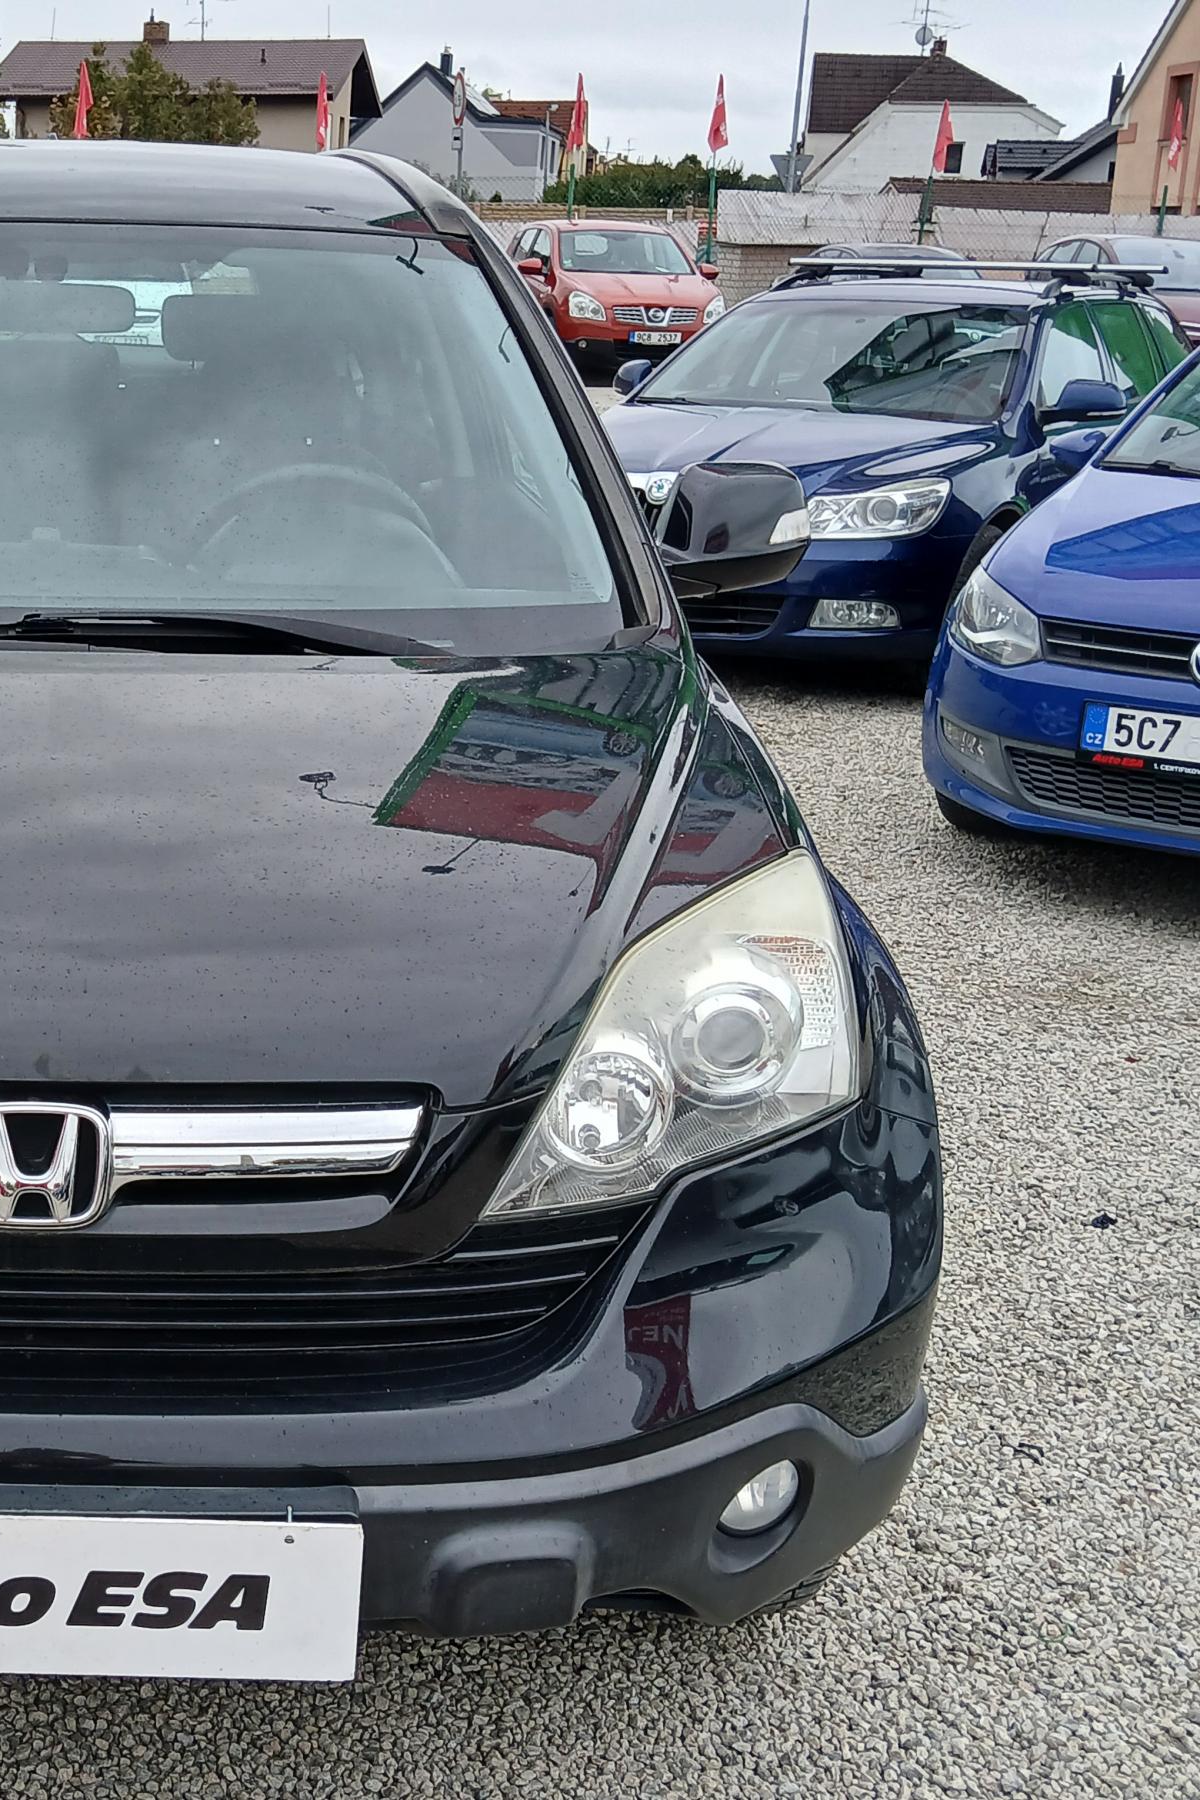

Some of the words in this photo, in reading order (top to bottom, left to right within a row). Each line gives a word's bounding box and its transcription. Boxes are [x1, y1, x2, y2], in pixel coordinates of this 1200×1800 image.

[636, 333, 652, 342] 9C8
[1086, 732, 1103, 745] CZ
[1114, 712, 1182, 754] 5C7
[1093, 753, 1121, 765] Auto
[65, 1569, 271, 1631] ESA
